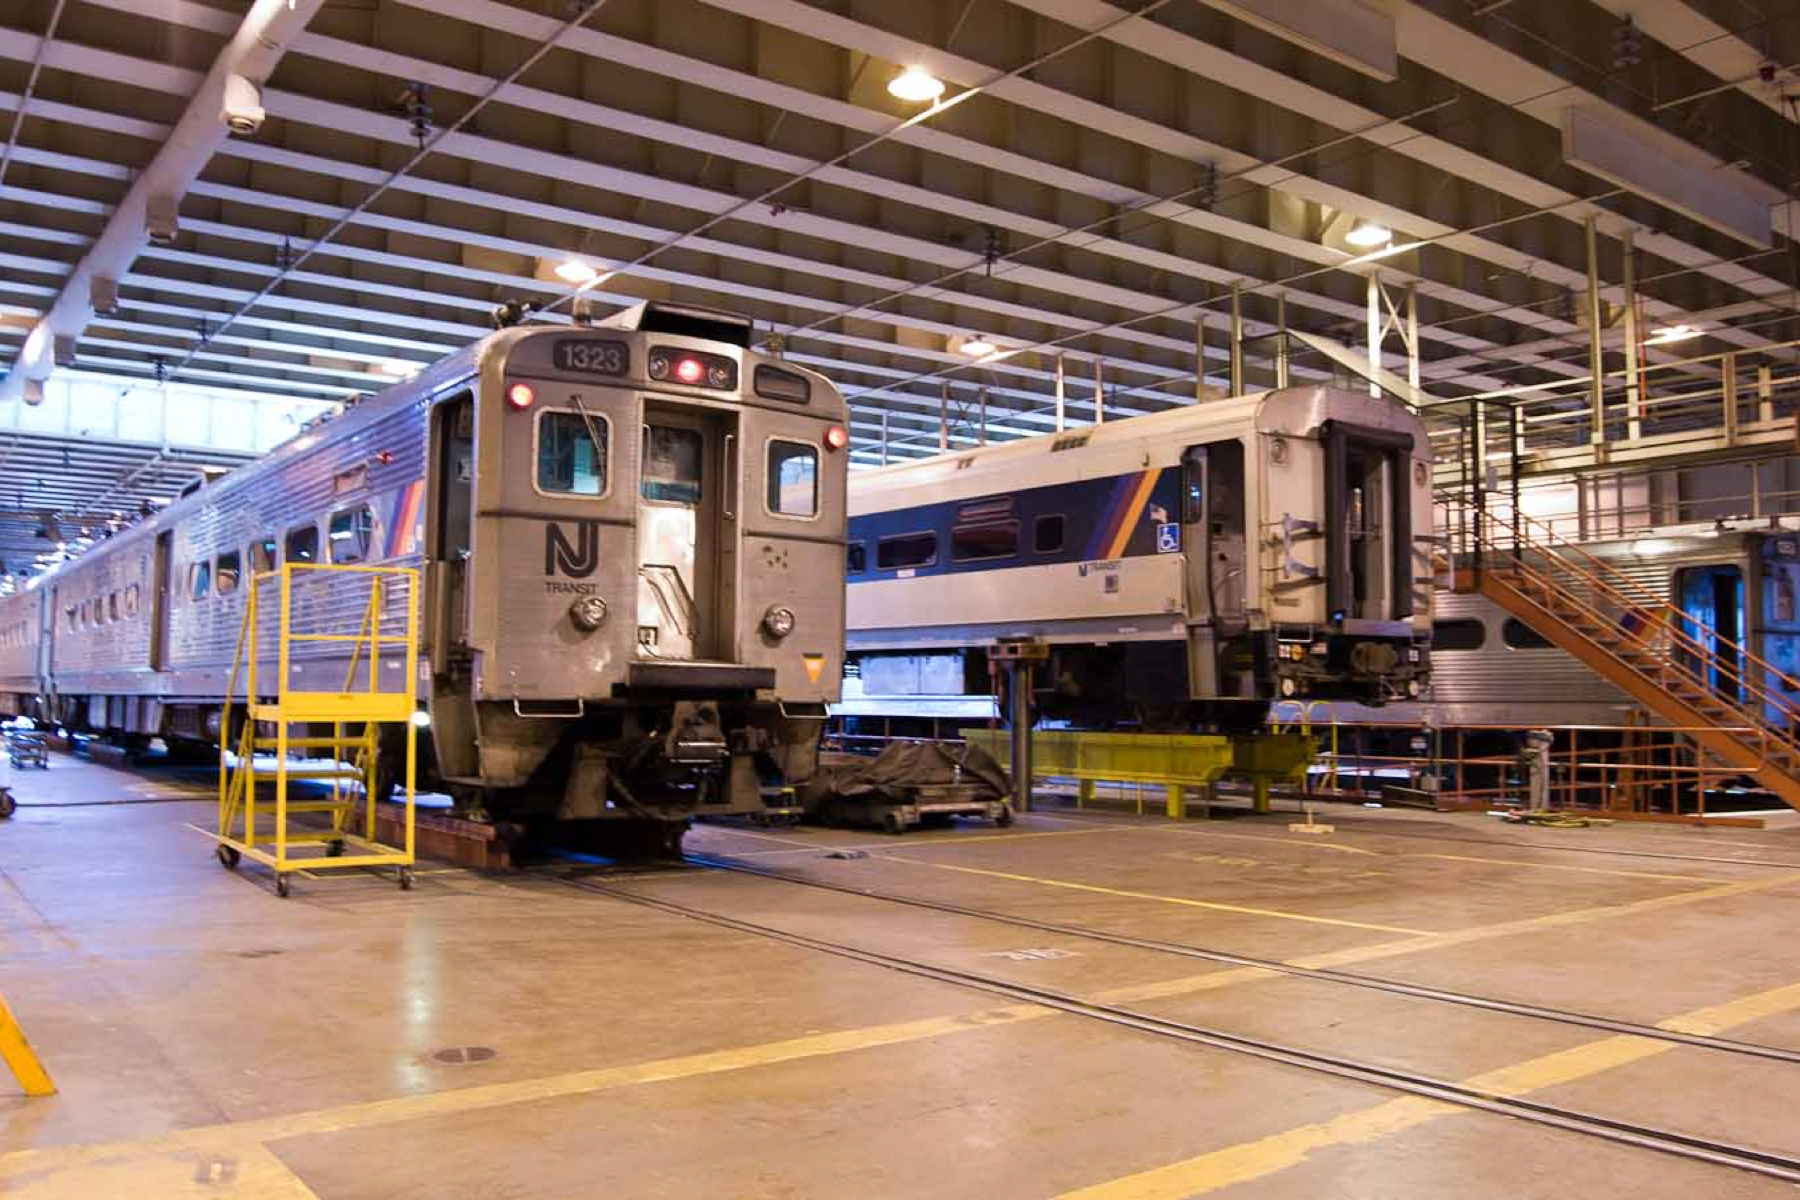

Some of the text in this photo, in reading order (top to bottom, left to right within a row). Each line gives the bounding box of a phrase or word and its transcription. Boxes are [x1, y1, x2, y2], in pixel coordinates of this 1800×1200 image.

[562, 344, 621, 373] 1323
[545, 521, 599, 578] NJ
[545, 581, 599, 595] TRANSIT
